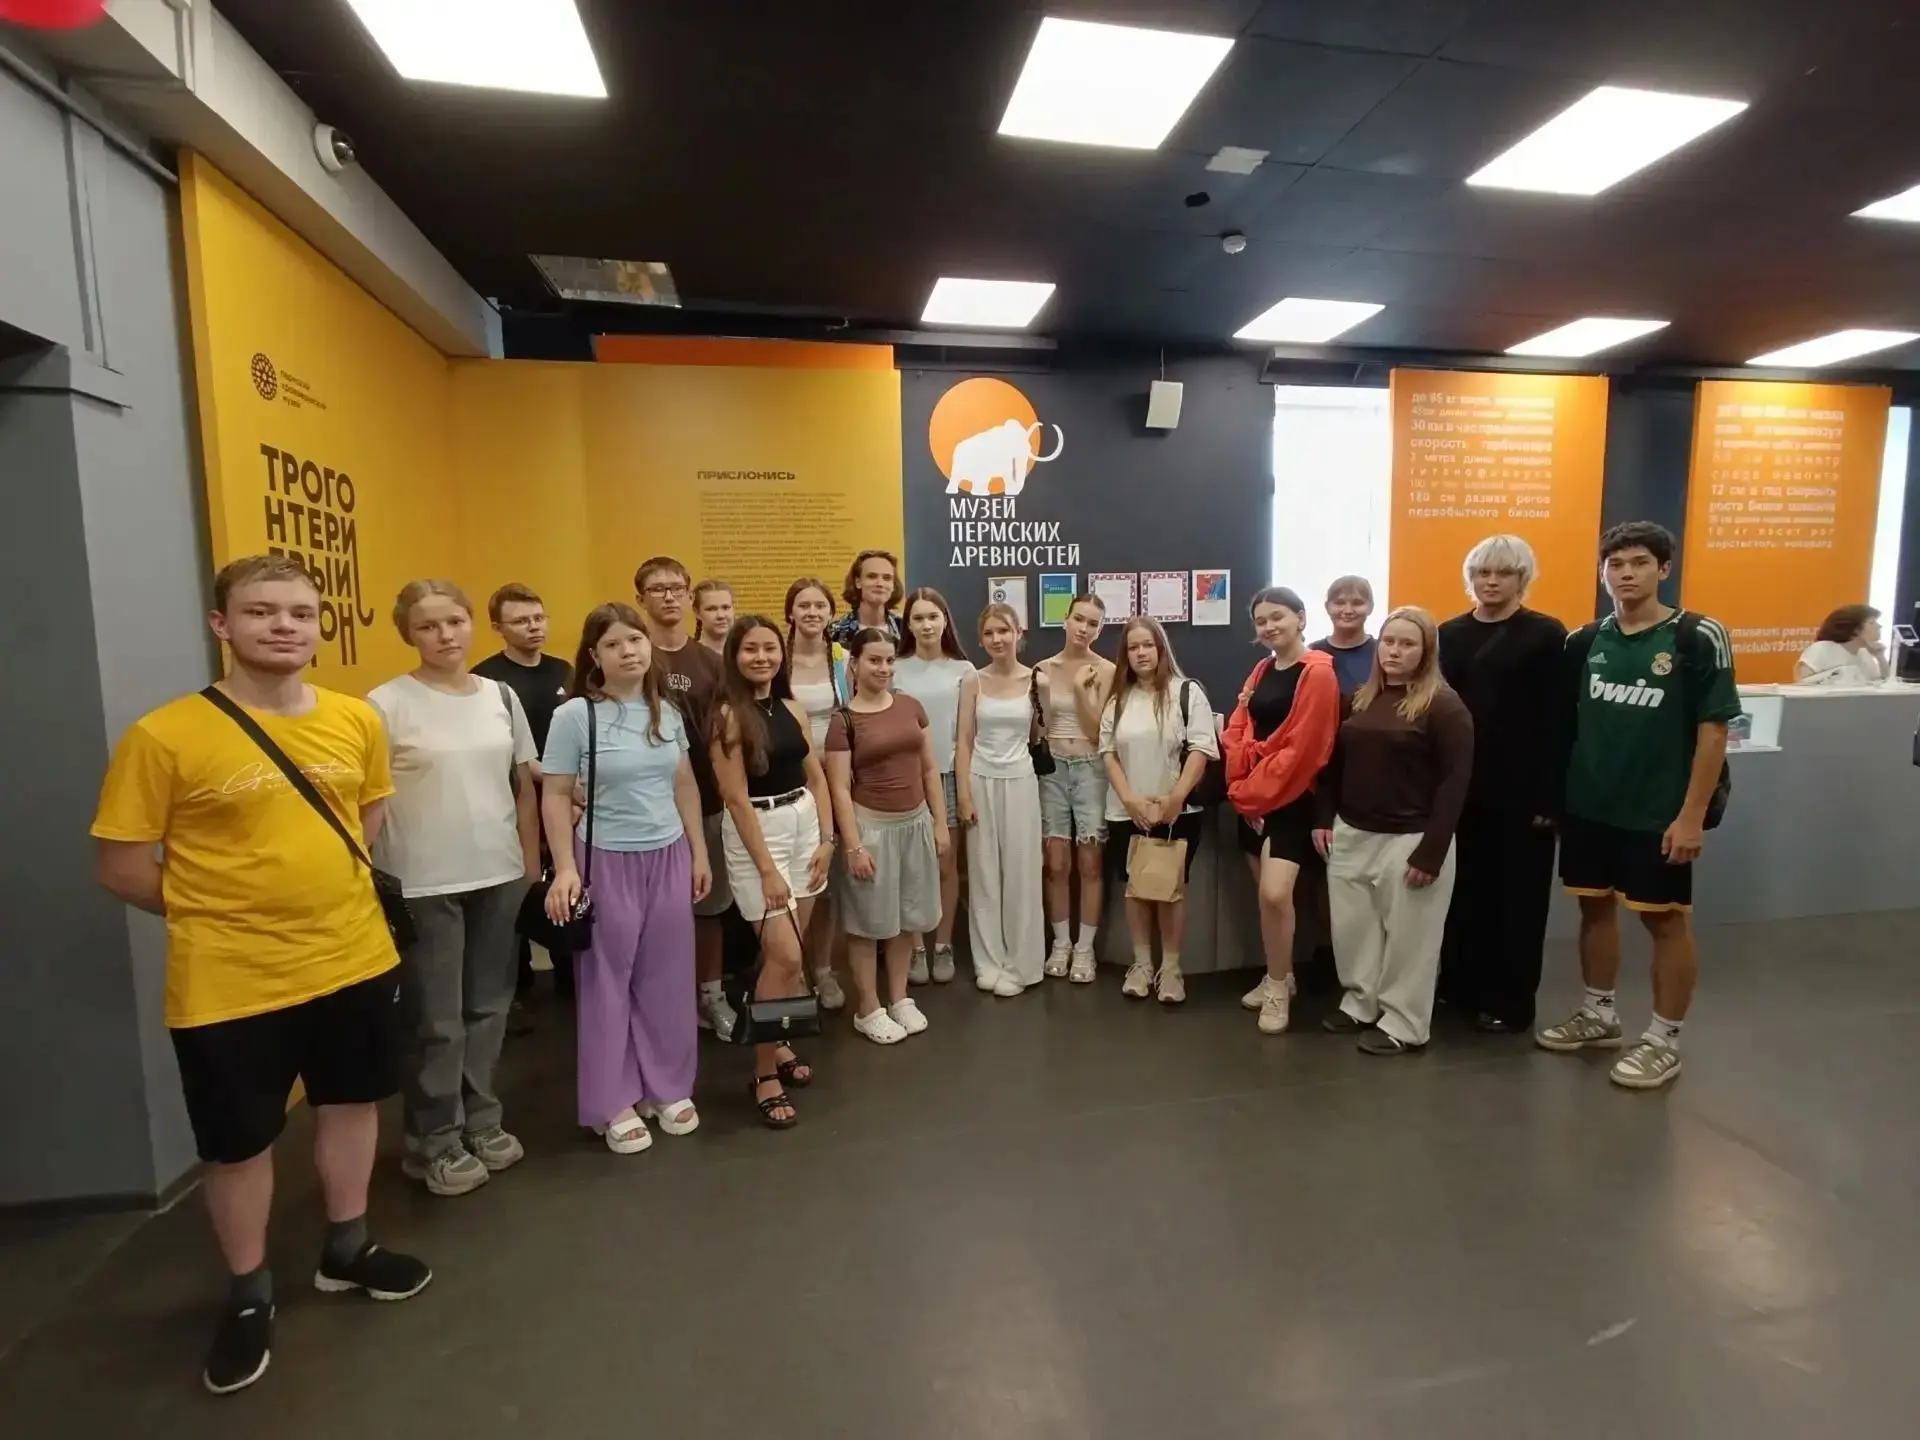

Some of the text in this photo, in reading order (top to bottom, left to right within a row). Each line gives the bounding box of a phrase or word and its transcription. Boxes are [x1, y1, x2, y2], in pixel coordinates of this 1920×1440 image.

[1410, 419, 1426, 431] 30
[1410, 438, 1466, 451] скорость
[260, 442, 355, 513] ТРОГО
[697, 470, 796, 481] ПРИСЛОНИСЬ
[950, 496, 1016, 519] МУЗЕЙ
[1465, 494, 1509, 505] размах
[1516, 496, 1551, 507] рогов
[1408, 506, 1550, 519] первобытного бизона
[264, 495, 359, 577] НТЕРИ
[950, 521, 1060, 543] ПЕРМСКИХ
[949, 543, 1080, 567] ДРЕВНОСТЕЙ
[311, 600, 358, 668] ОН
[1589, 672, 1665, 708] bwin
